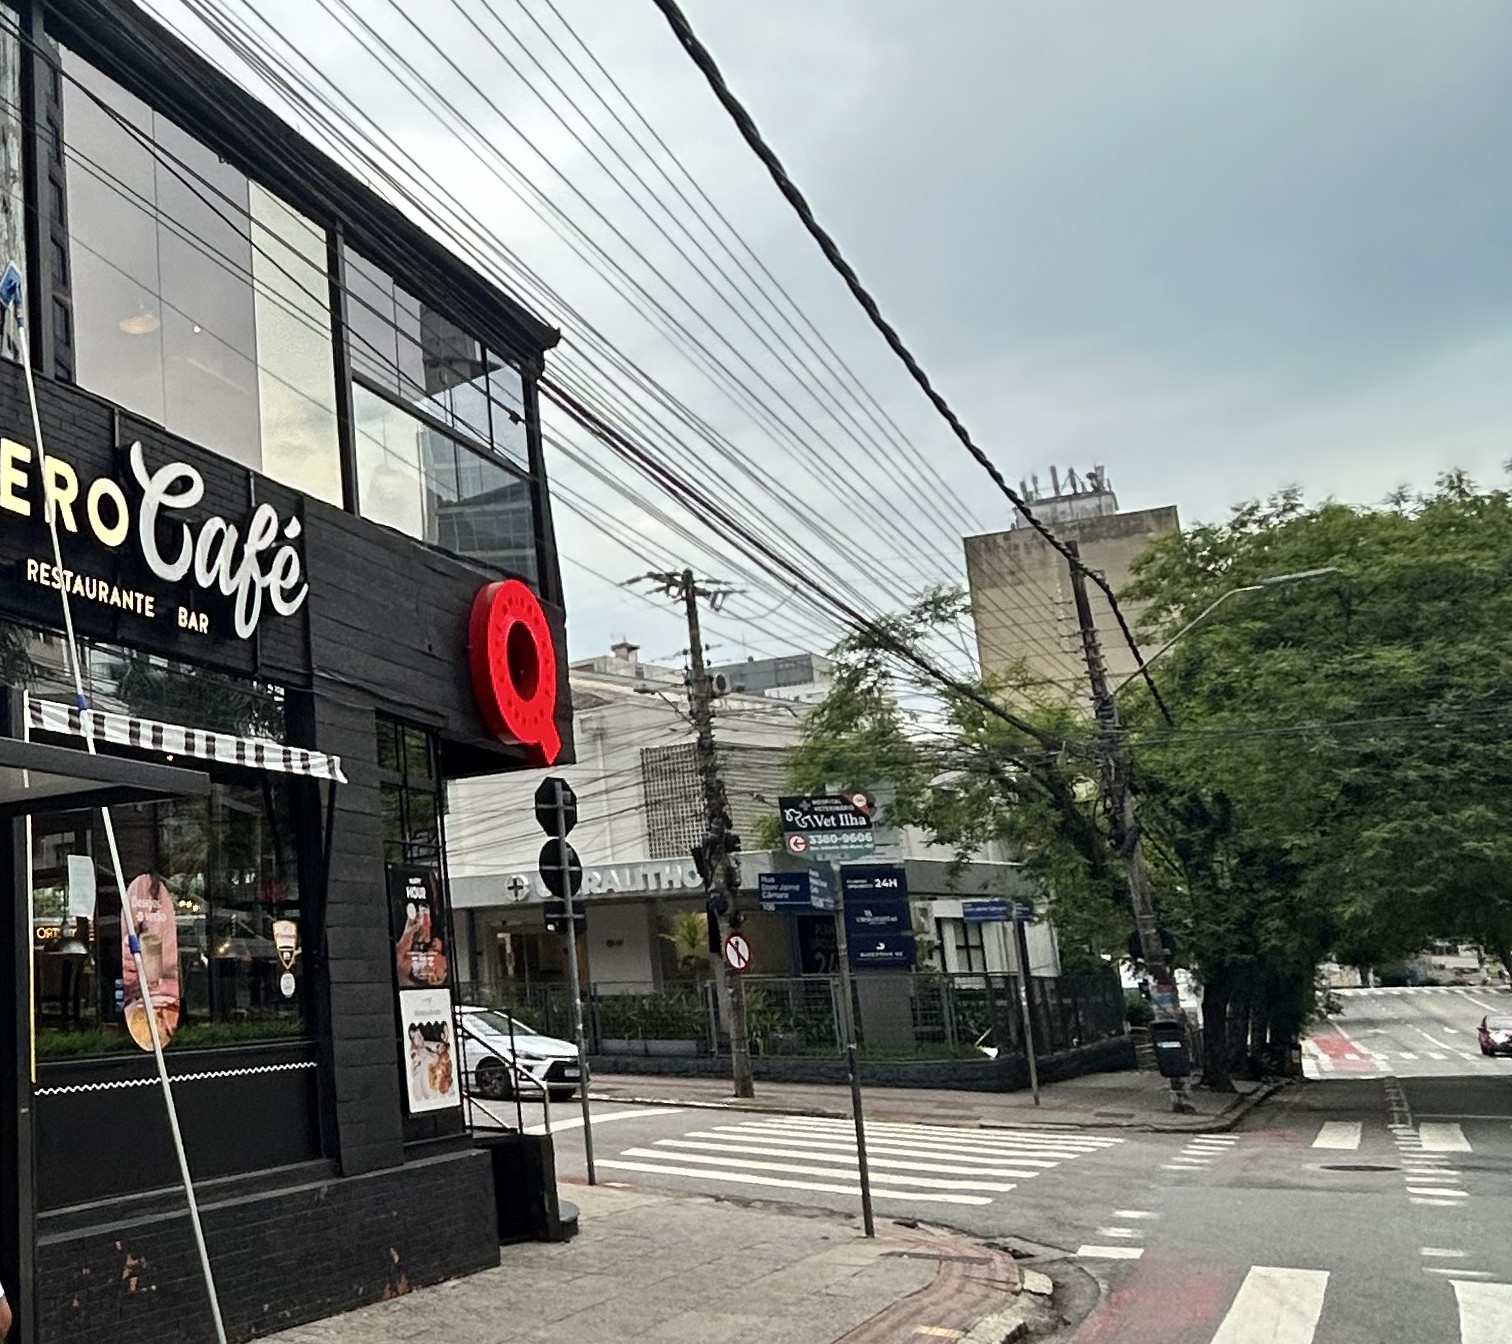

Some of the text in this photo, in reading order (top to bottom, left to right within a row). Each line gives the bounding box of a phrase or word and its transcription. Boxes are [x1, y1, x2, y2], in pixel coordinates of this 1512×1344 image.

[129, 440, 309, 640] Café
[27, 558, 155, 618] RESTAURANTE
[178, 606, 210, 635] BAR
[813, 812, 867, 827] Vet Ilha
[874, 878, 898, 888] 24H
